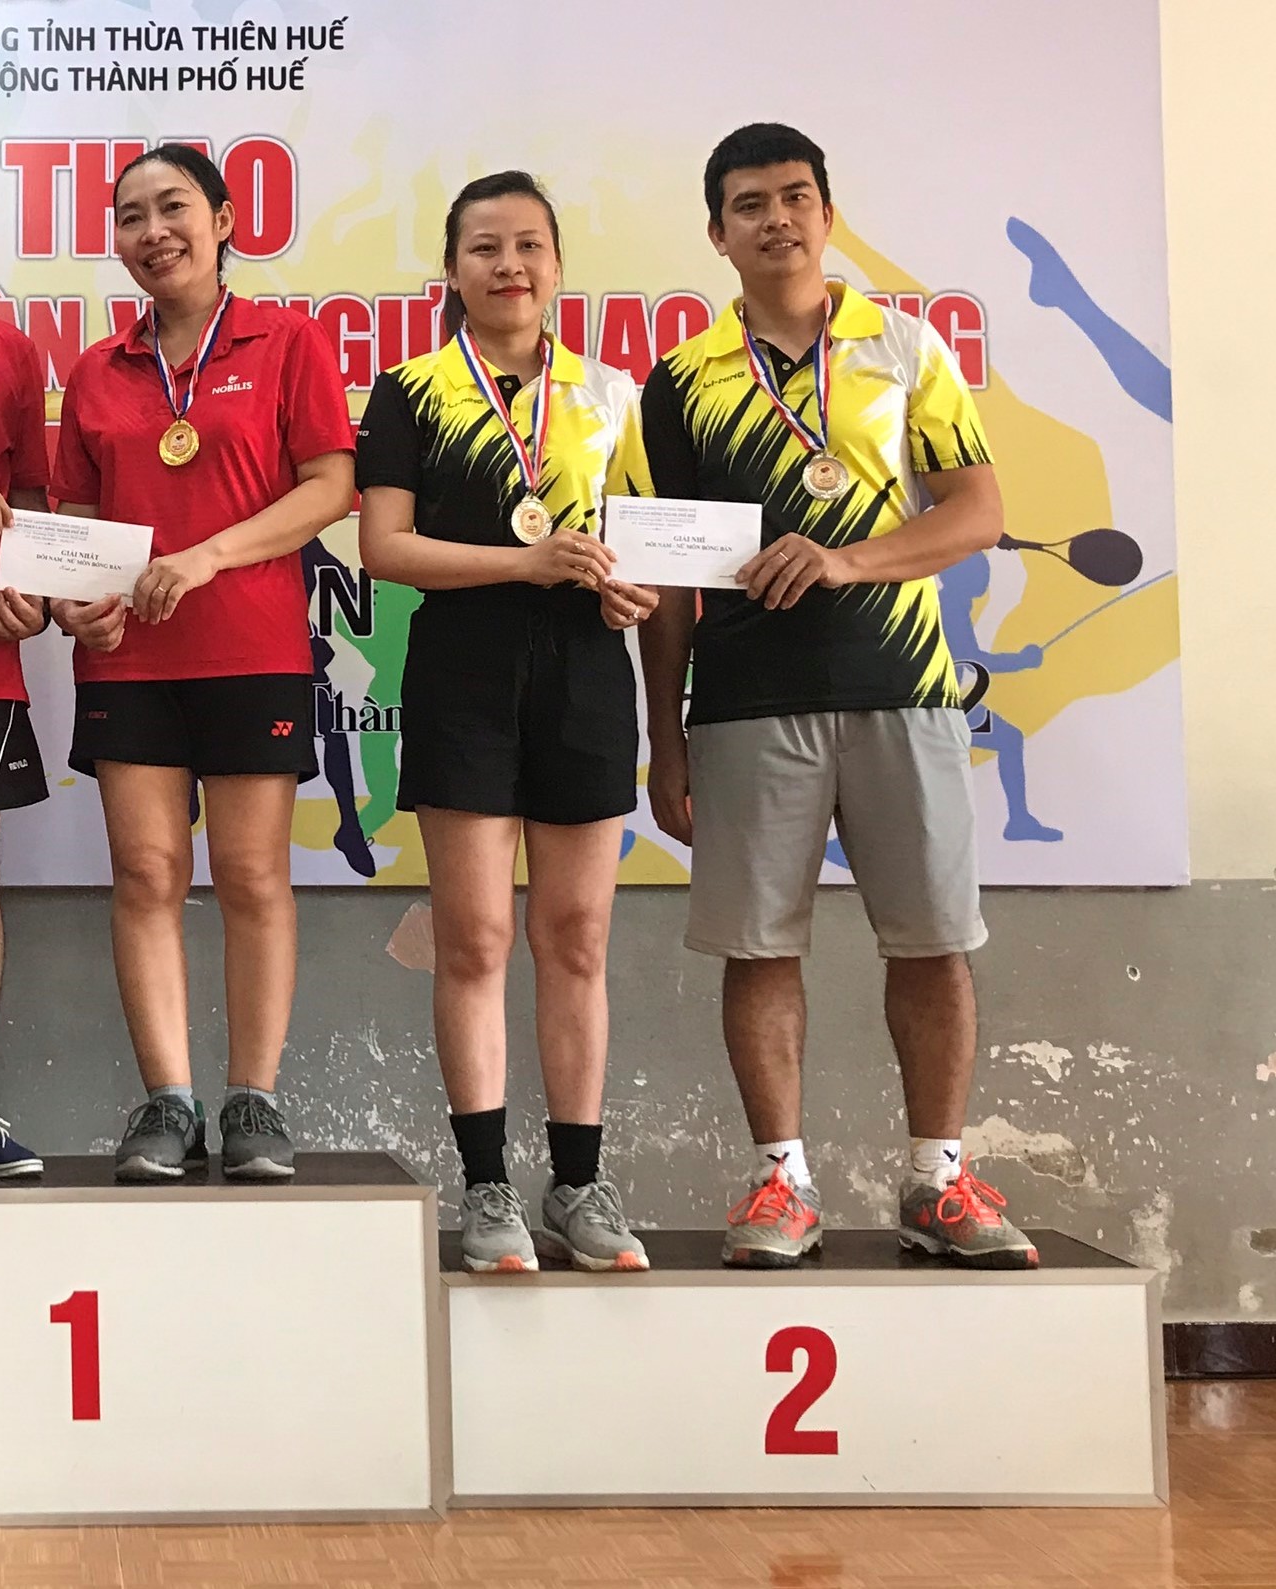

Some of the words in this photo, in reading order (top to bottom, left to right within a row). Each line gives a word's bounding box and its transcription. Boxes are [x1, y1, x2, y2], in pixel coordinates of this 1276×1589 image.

[28, 18, 96, 51] TỈNH
[104, 20, 184, 51] THỪA
[192, 20, 276, 51] THIÊN
[286, 16, 349, 50] HUẾ
[68, 60, 168, 91] THÀNH
[178, 56, 240, 91] PHỐ
[247, 56, 309, 91] HUẾ
[1, 136, 297, 260] THO
[211, 381, 253, 395] NOBILIS
[703, 371, 745, 388] LI-NING
[50, 1291, 100, 1420] 1
[765, 1326, 838, 1454] 2
